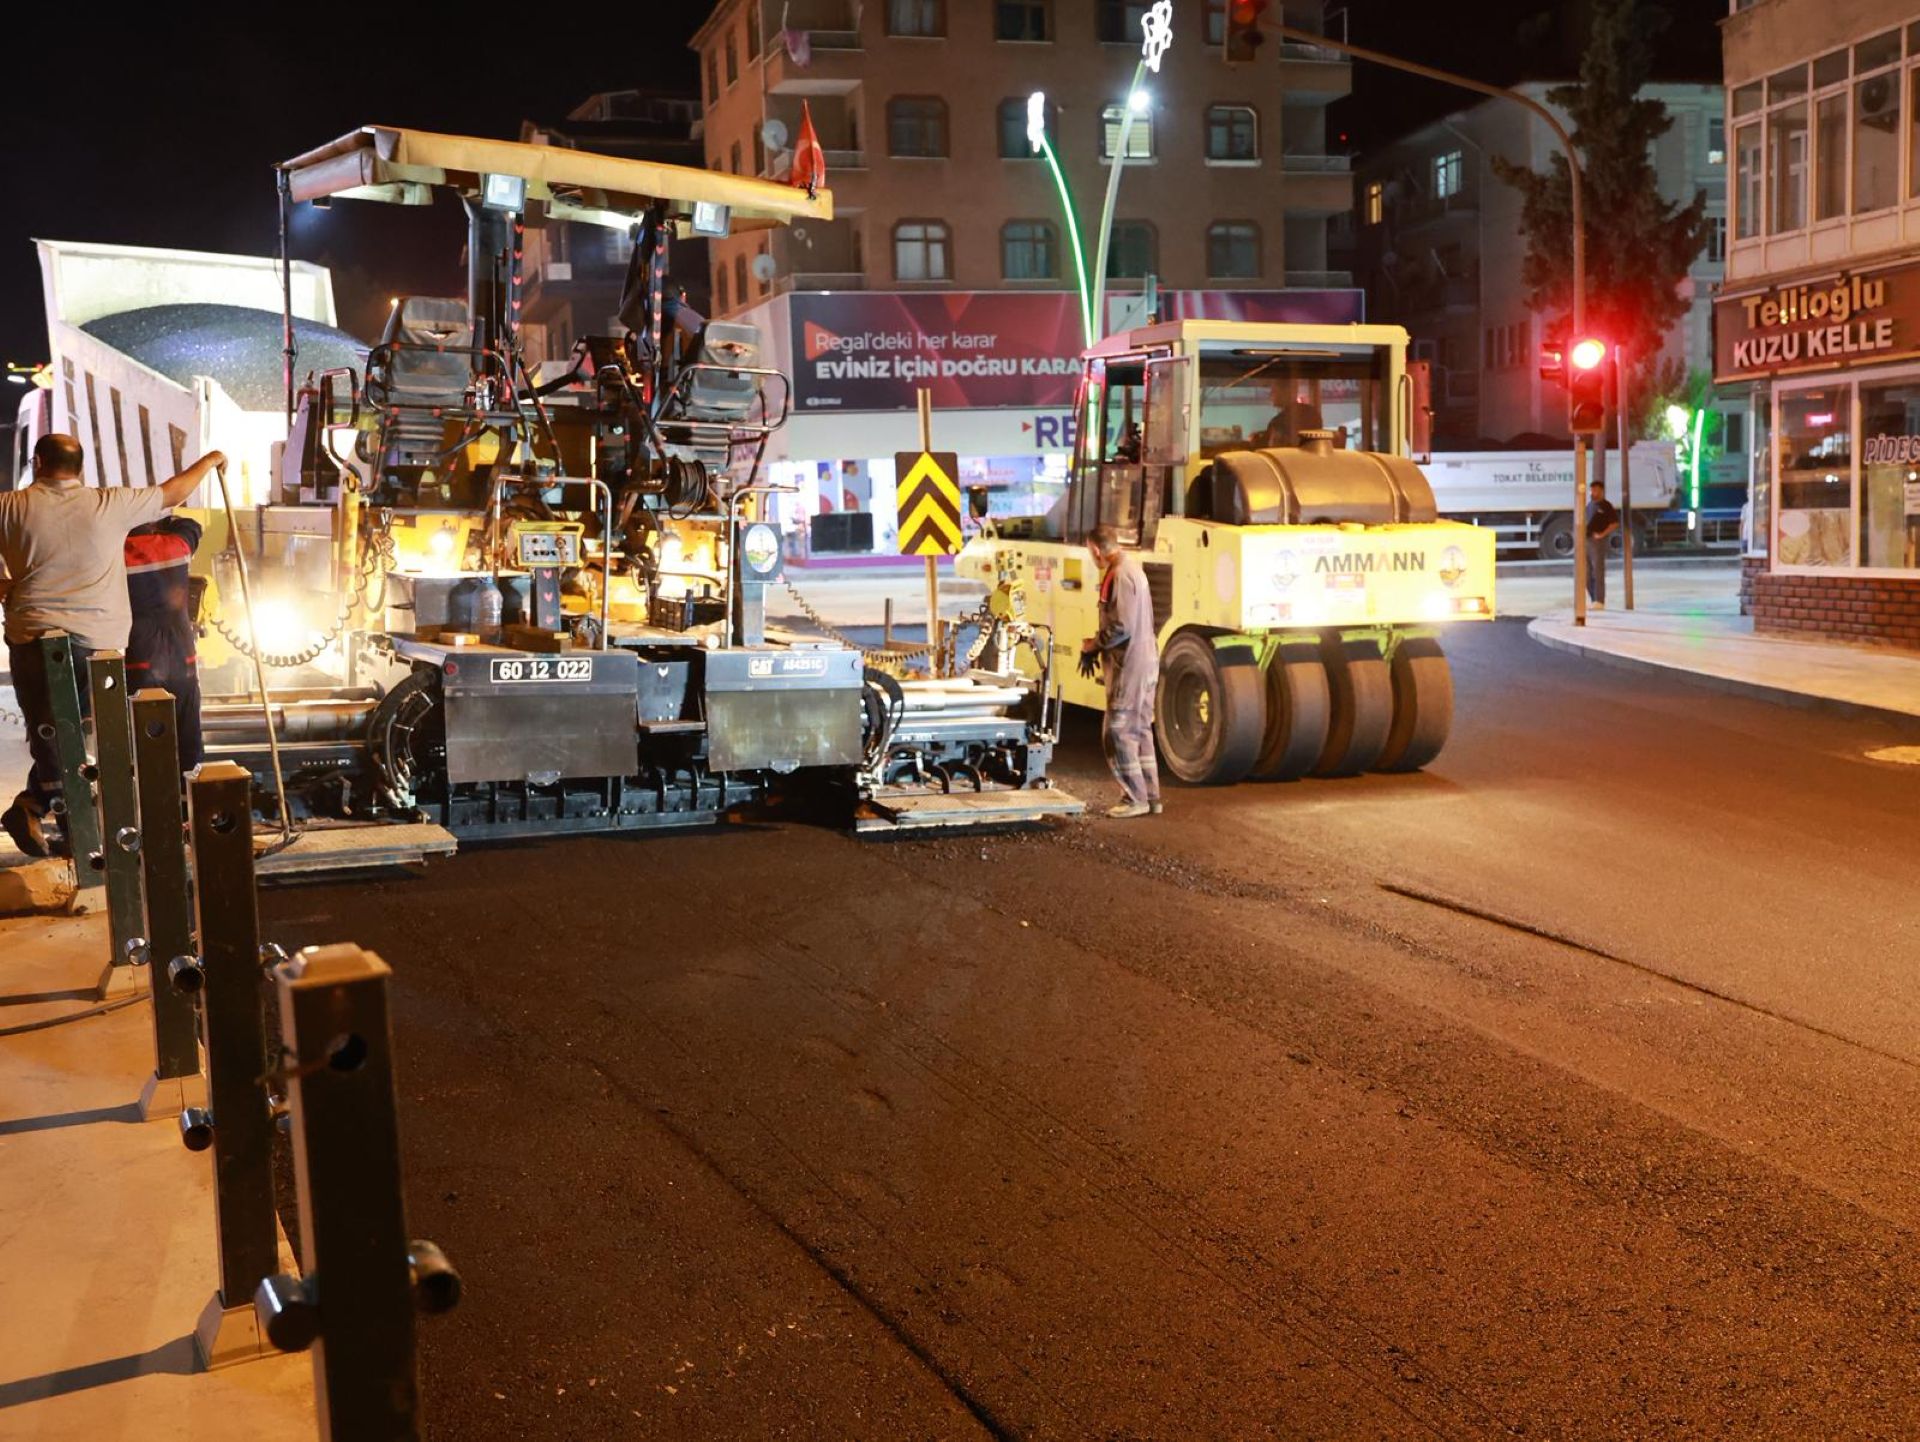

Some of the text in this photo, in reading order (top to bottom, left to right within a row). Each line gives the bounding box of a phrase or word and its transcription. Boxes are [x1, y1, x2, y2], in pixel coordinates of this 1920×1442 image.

[1741, 276, 1884, 329] Tellioğlu
[815, 331, 998, 354] Regal'deki her karar
[1733, 318, 1893, 368] KUZU KELLE
[816, 354, 1082, 382] EVİNİZ İÇİN DOĞRU KARA
[1493, 471, 1574, 483] TOKAT BELEDİYES
[1314, 551, 1425, 573] AMMANN
[499, 660, 591, 680] 60 12 022
[751, 659, 774, 674] CAT
